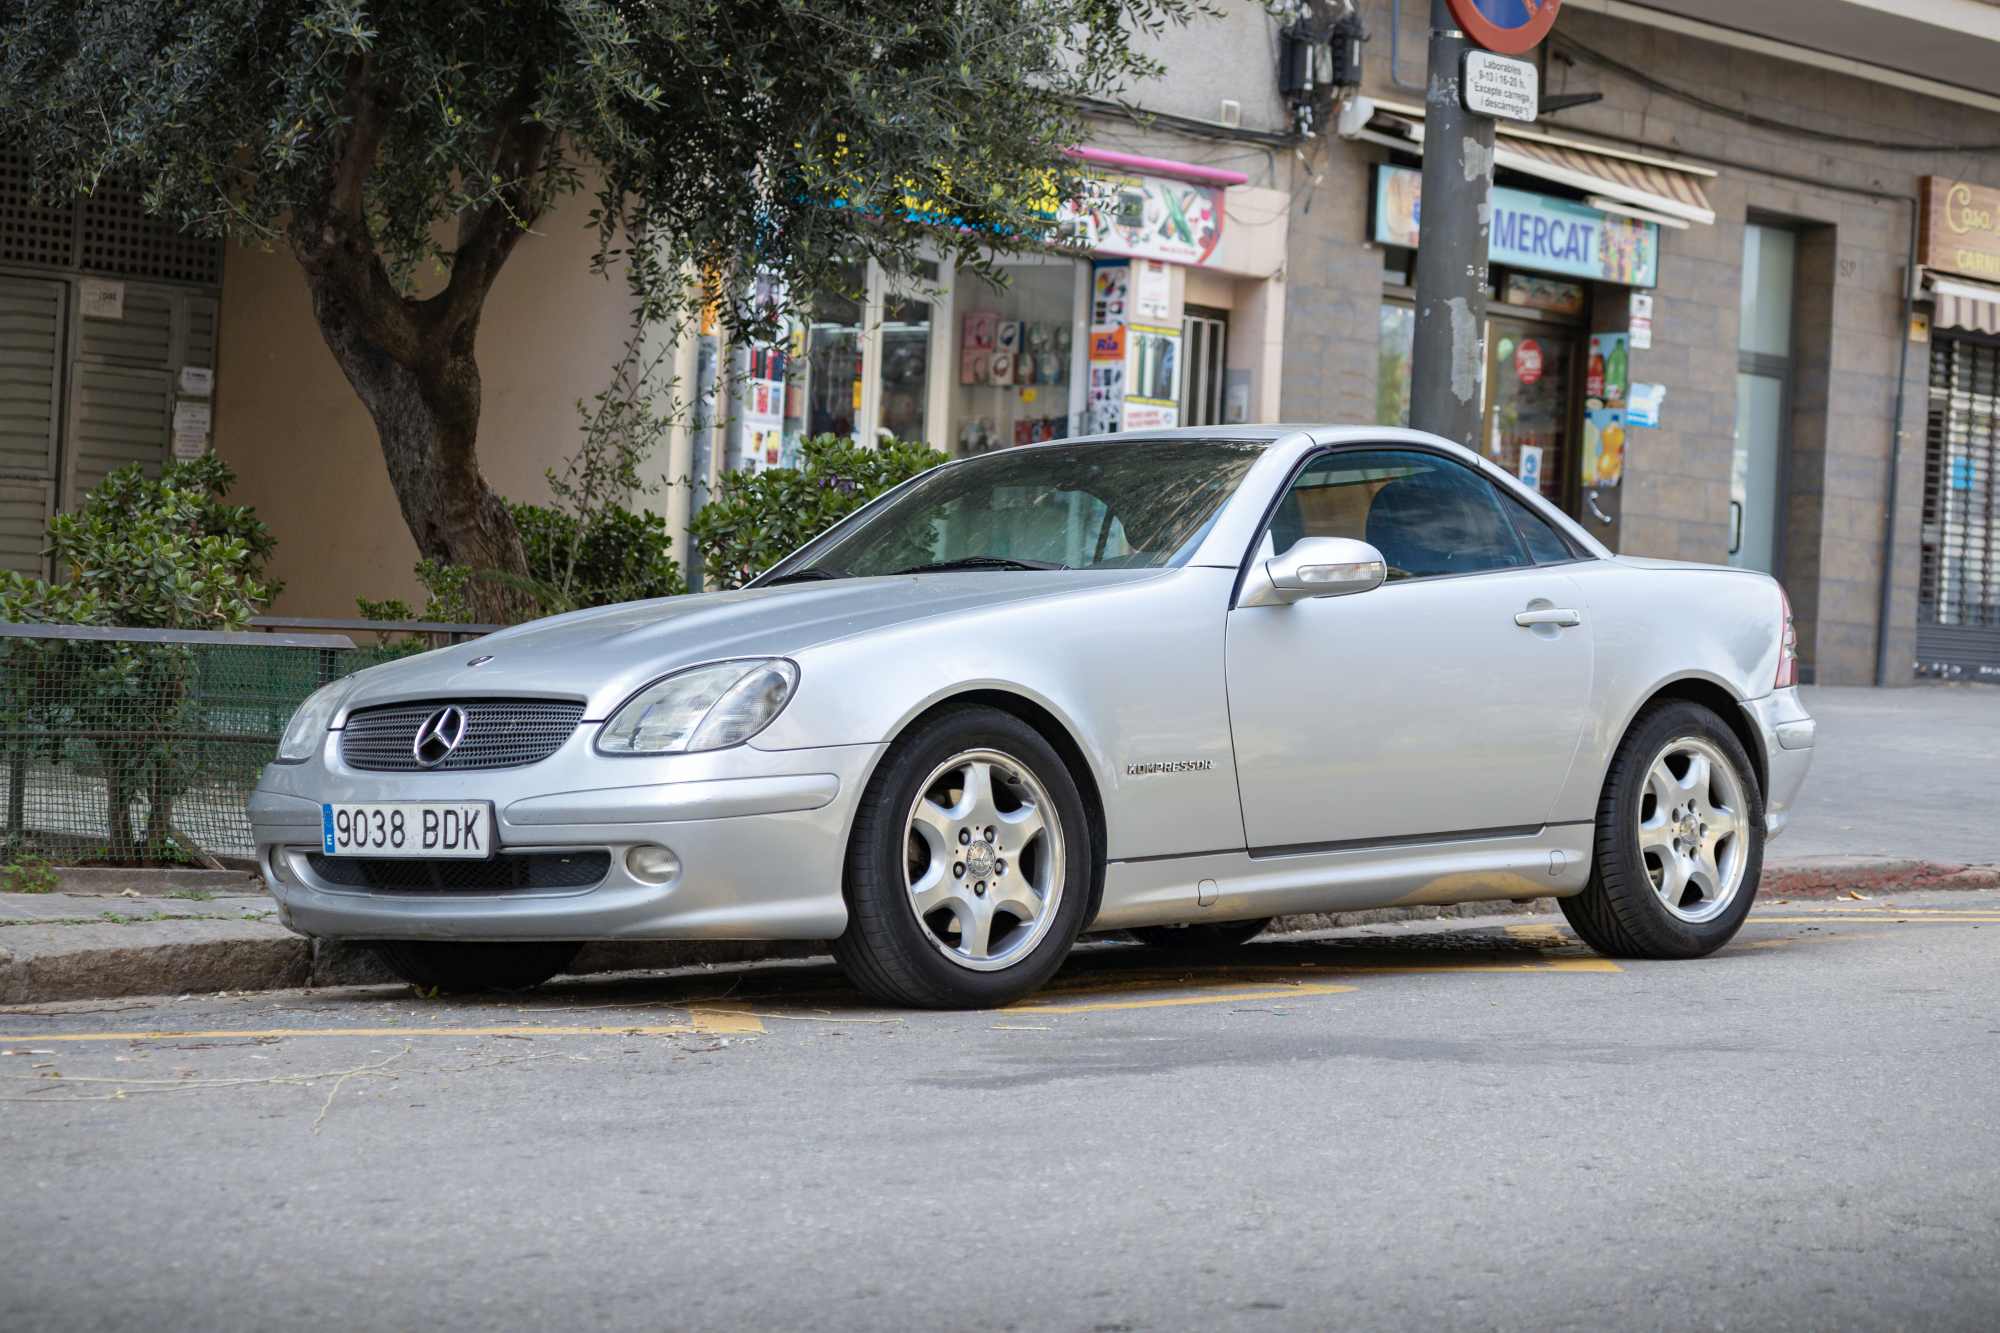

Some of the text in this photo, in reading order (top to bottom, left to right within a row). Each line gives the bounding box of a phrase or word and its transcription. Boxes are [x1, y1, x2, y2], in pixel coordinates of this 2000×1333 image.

[1483, 57, 1521, 75] Laborables
[1474, 81, 1502, 96] Excepte
[1945, 182, 1992, 234] Casa
[1493, 208, 1594, 264] MERCAT
[1127, 759, 1214, 775] KOMPRESSOR
[326, 809, 480, 849] E 9038 BDK
